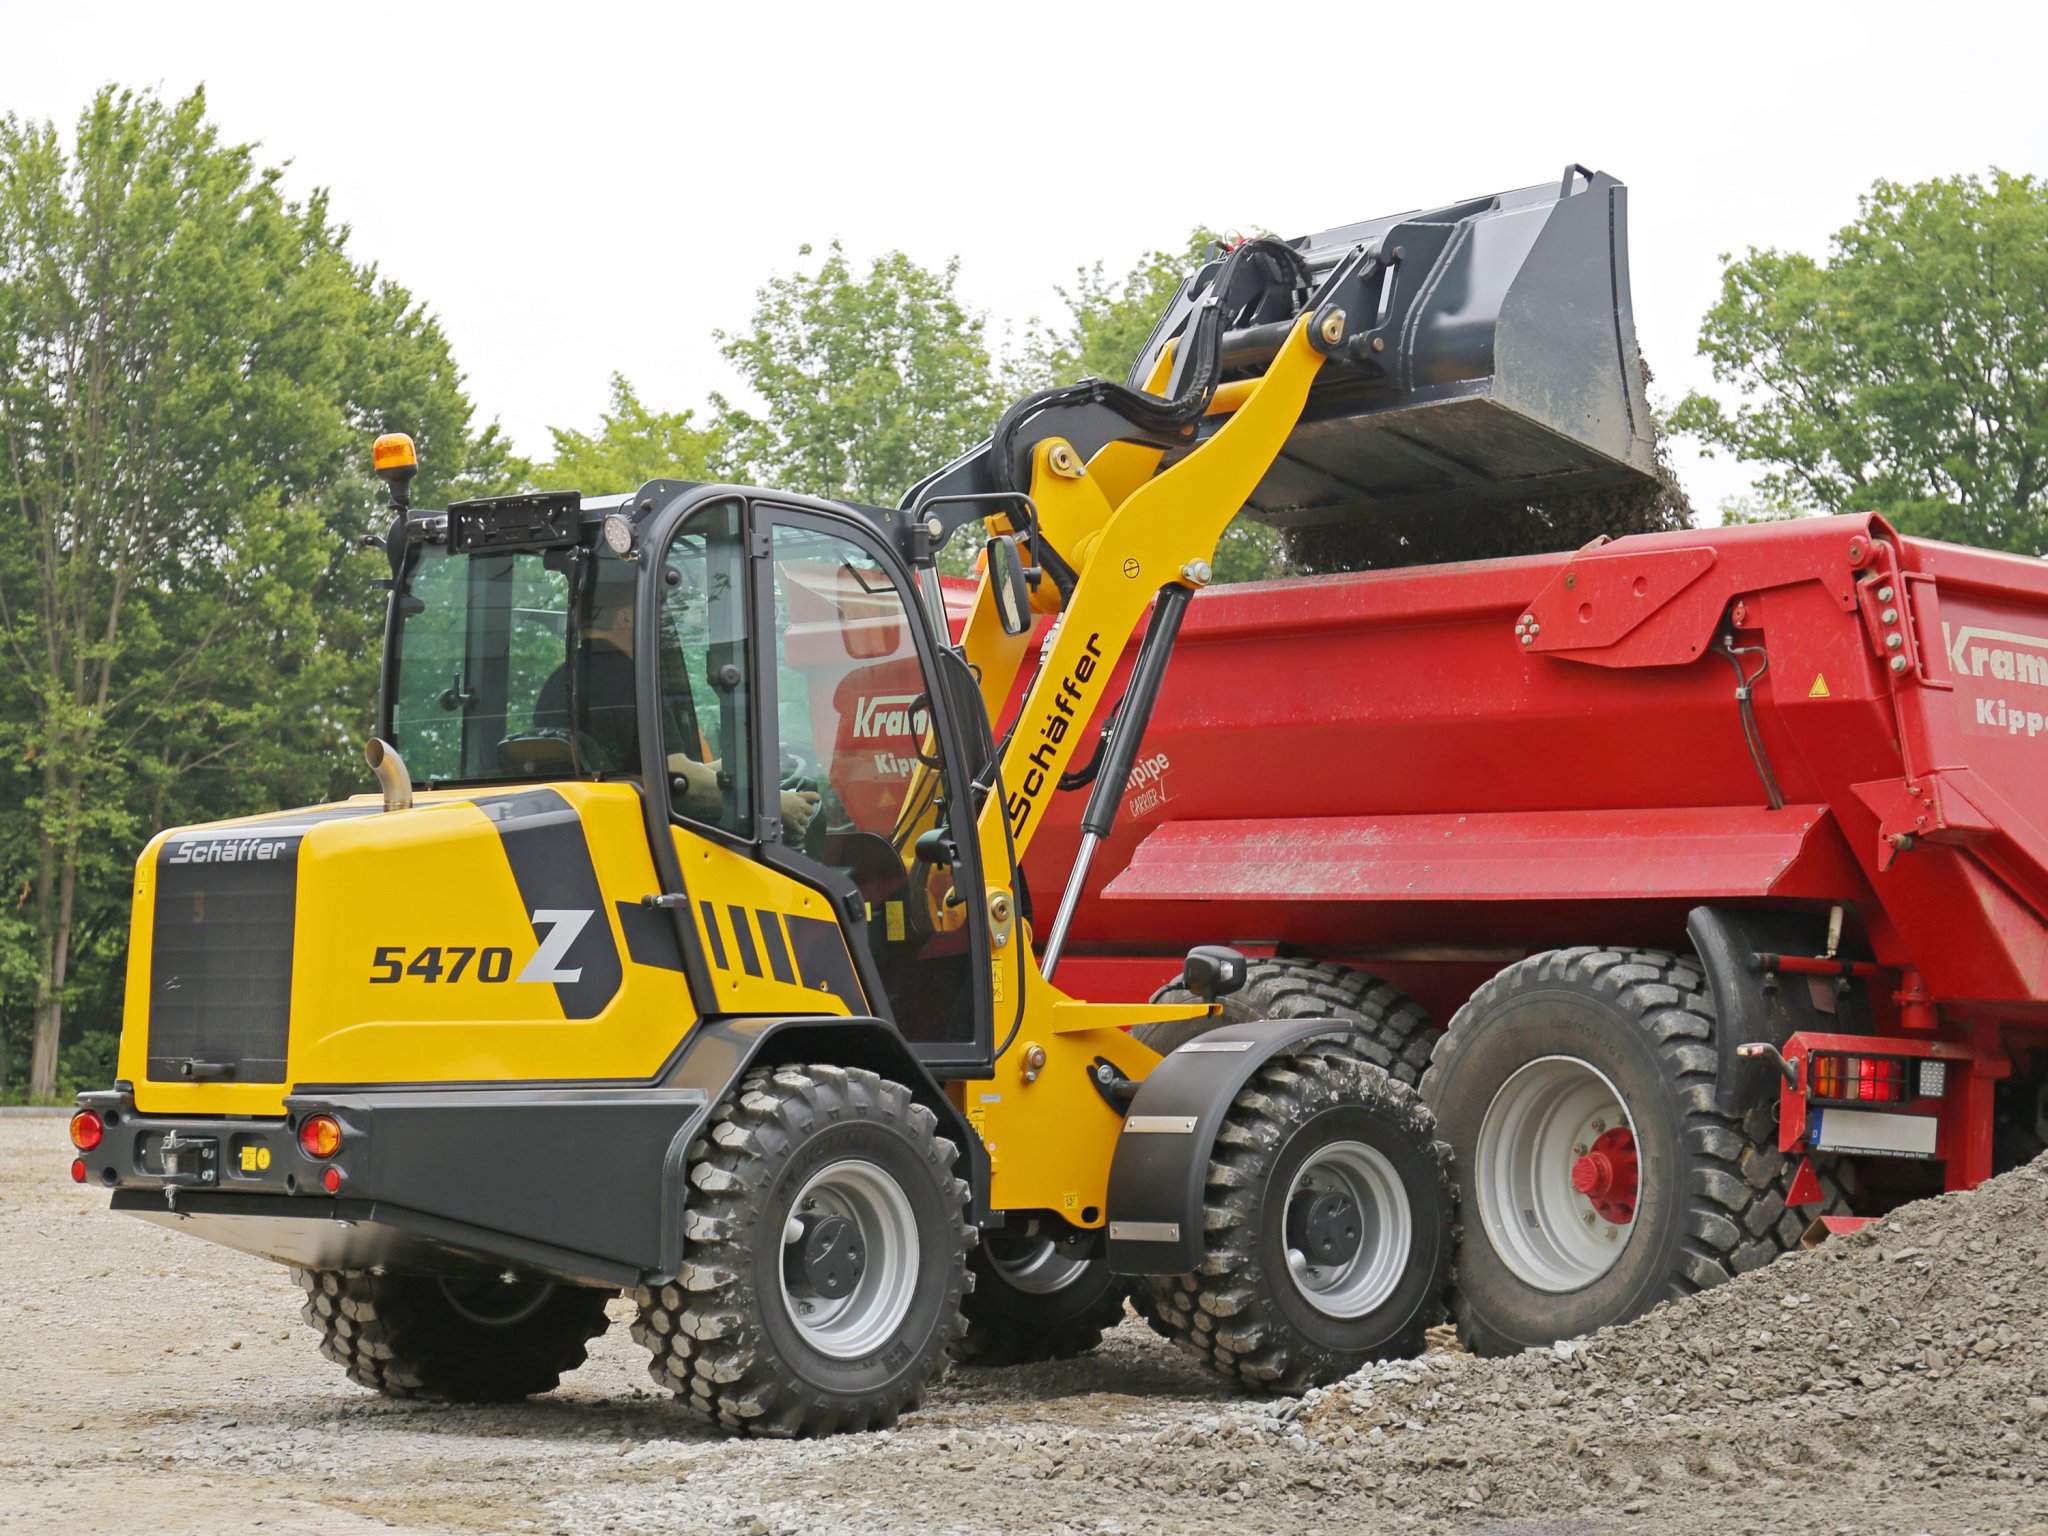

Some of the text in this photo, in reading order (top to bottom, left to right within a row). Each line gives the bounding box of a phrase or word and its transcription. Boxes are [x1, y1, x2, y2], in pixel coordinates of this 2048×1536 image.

[1976, 698, 2048, 737] Kipp
[1008, 632, 1101, 840] Schäffer
[1129, 788, 1160, 817] CARRIER
[169, 838, 286, 864] Schäffer
[369, 909, 596, 984] 5470 Z
[1812, 1129, 1819, 1138] D
